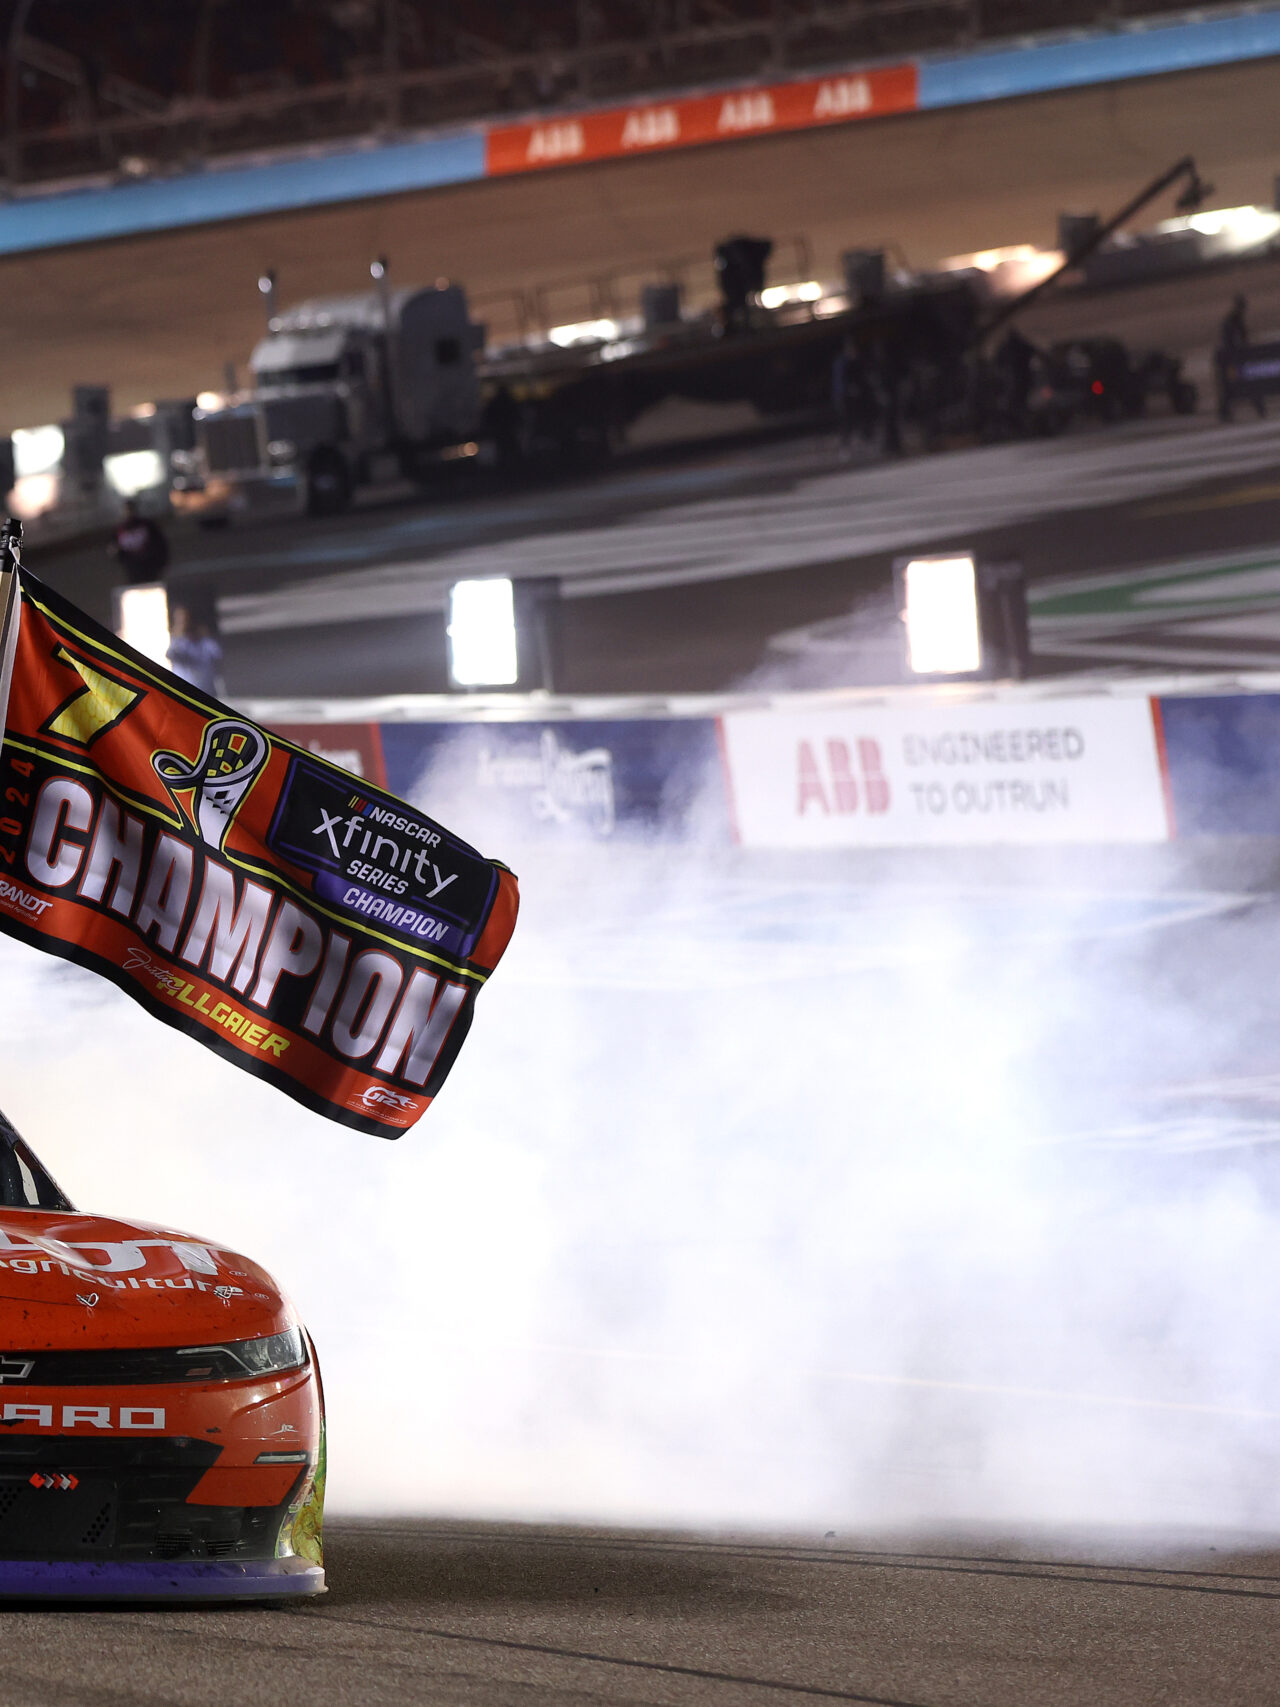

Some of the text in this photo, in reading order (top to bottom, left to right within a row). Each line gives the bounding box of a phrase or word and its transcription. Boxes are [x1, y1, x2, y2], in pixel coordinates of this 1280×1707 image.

[41, 642, 146, 750] 7
[796, 735, 891, 817] ABB
[902, 727, 1084, 766] ENGINEERED
[369, 806, 442, 849] NASCAR
[910, 779, 1070, 816] TO OUTRUN
[311, 807, 459, 899] xfinity
[346, 860, 409, 895] SERIES
[24, 775, 470, 1088] CHAMPION
[342, 887, 450, 942] CHAMPION
[156, 976, 291, 1058] ALLGAIER
